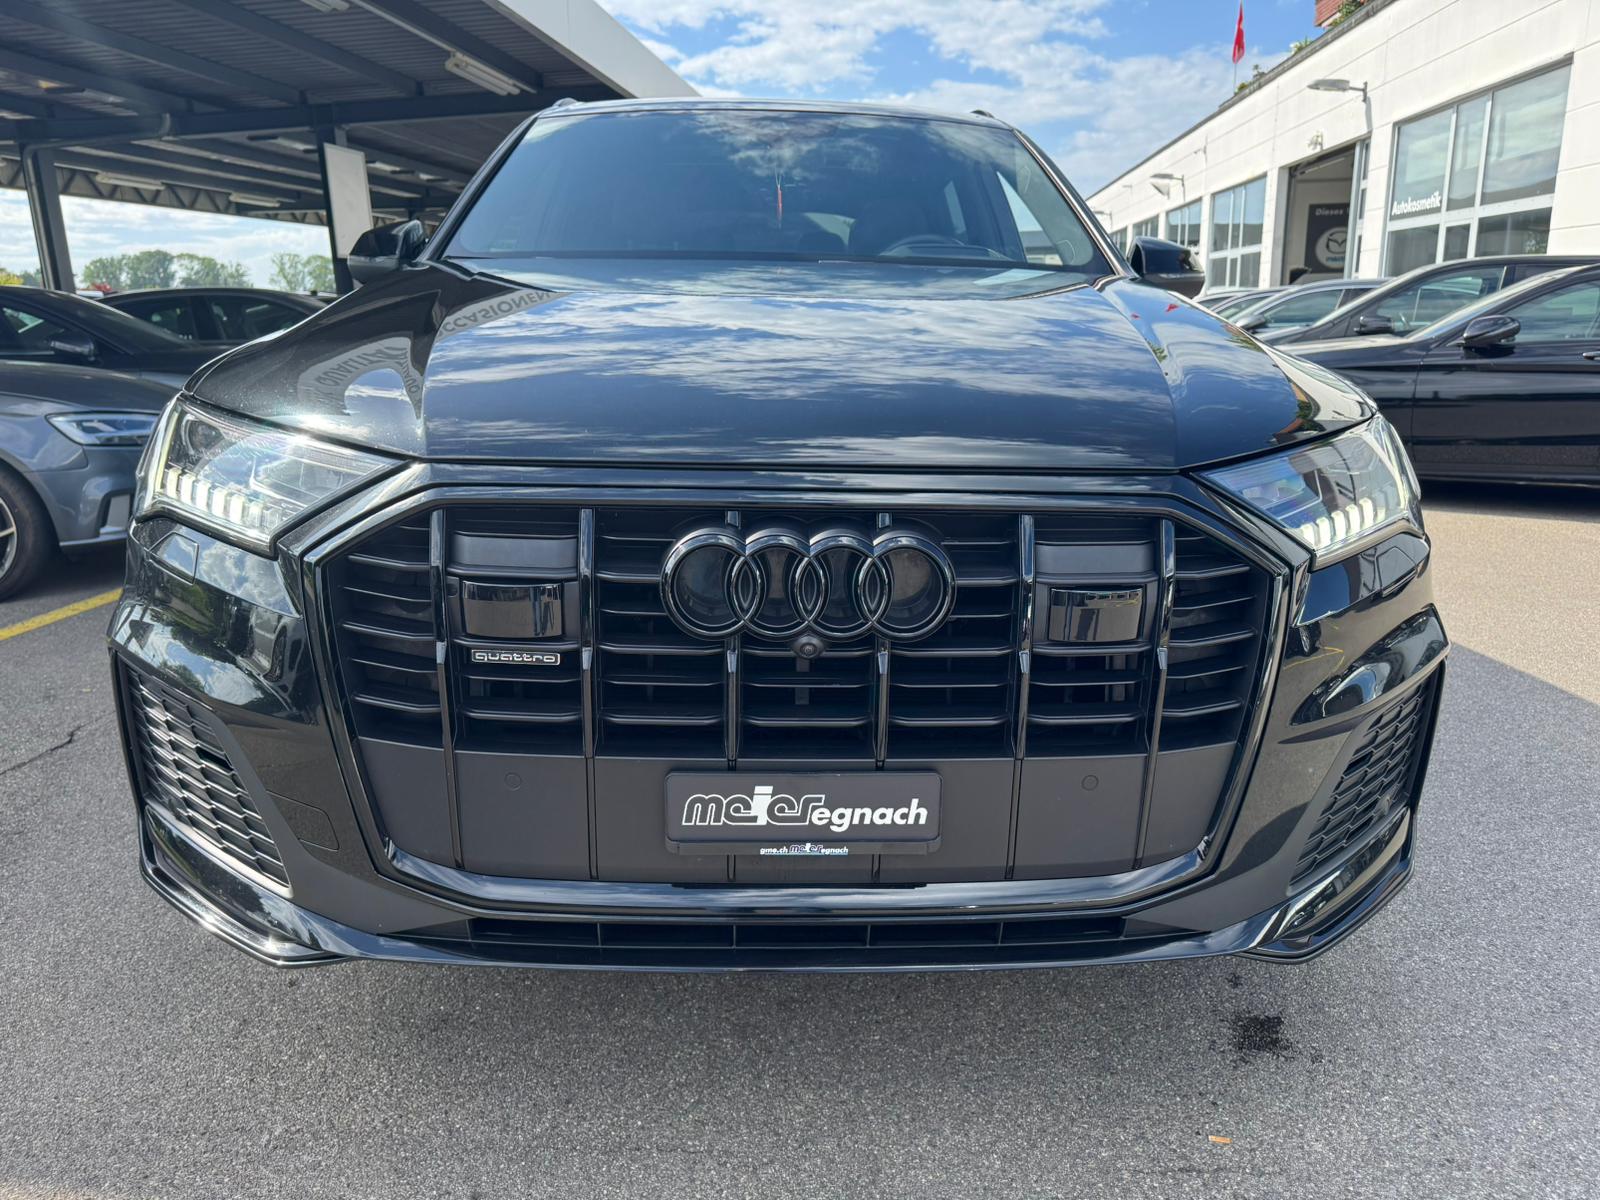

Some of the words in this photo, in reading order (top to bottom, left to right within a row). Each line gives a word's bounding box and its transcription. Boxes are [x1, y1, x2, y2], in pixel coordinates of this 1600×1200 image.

[1391, 190, 1442, 216] Autokosmetik
[474, 651, 557, 664] quattro
[811, 798, 929, 833] egnach
